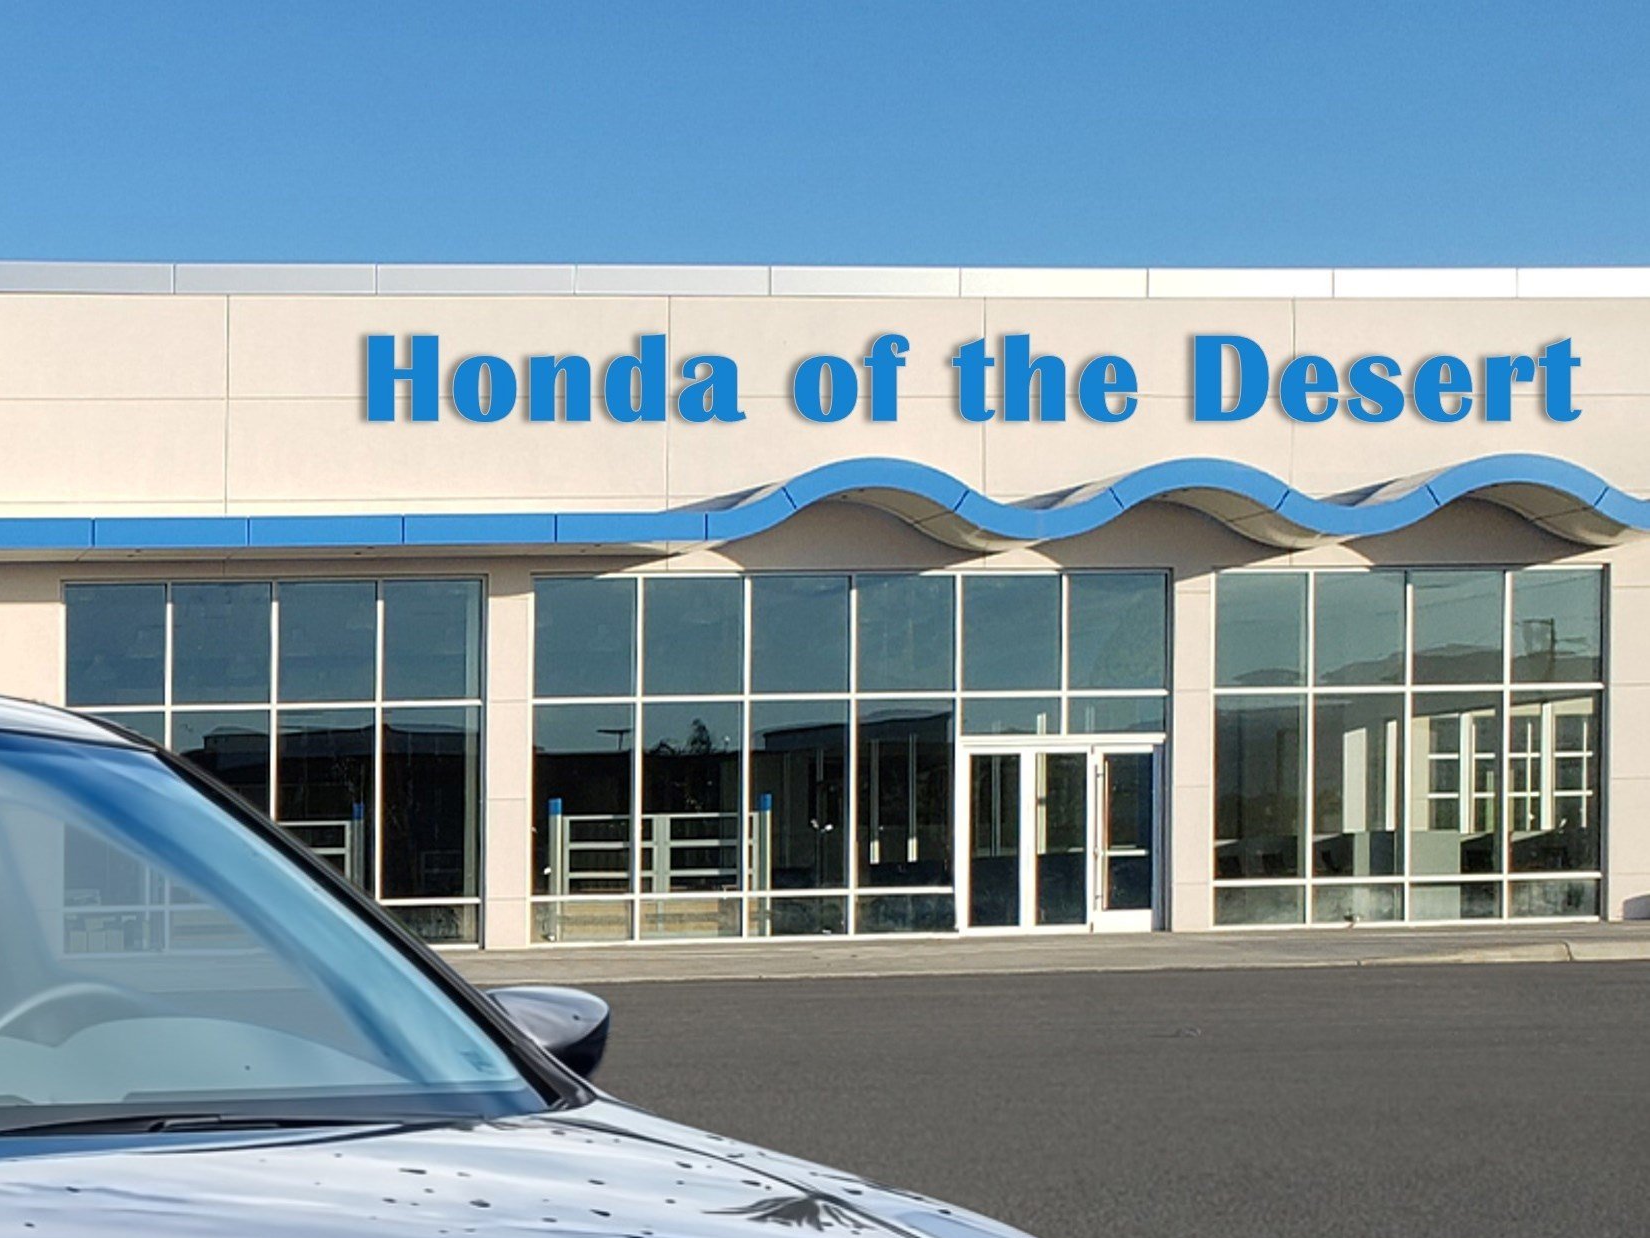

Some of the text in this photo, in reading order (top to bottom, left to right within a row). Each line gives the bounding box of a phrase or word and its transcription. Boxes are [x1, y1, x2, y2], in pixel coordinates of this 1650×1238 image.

[366, 332, 1582, 423] Honda of the Desert
